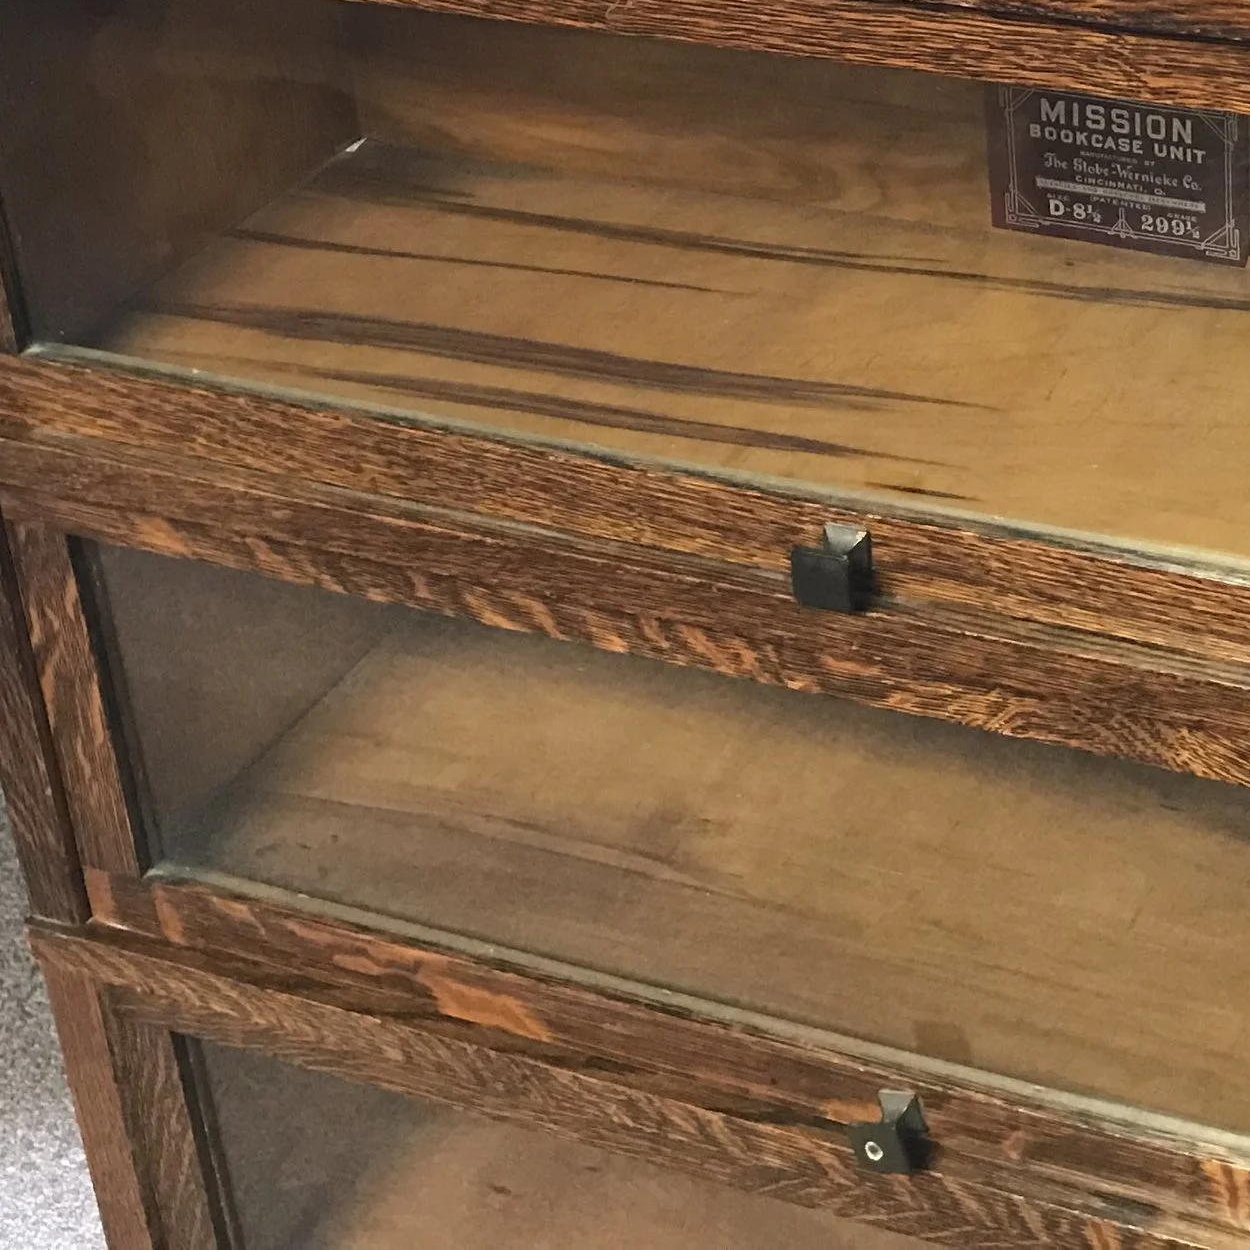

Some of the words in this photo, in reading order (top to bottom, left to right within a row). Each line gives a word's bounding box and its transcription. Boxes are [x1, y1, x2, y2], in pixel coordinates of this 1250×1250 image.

[1040, 98, 1193, 145] MISSION
[1029, 123, 1144, 155] BOOKCASE
[1154, 143, 1206, 164] UNIT
[1044, 152, 1068, 170] The
[1182, 174, 1202, 191] Co.
